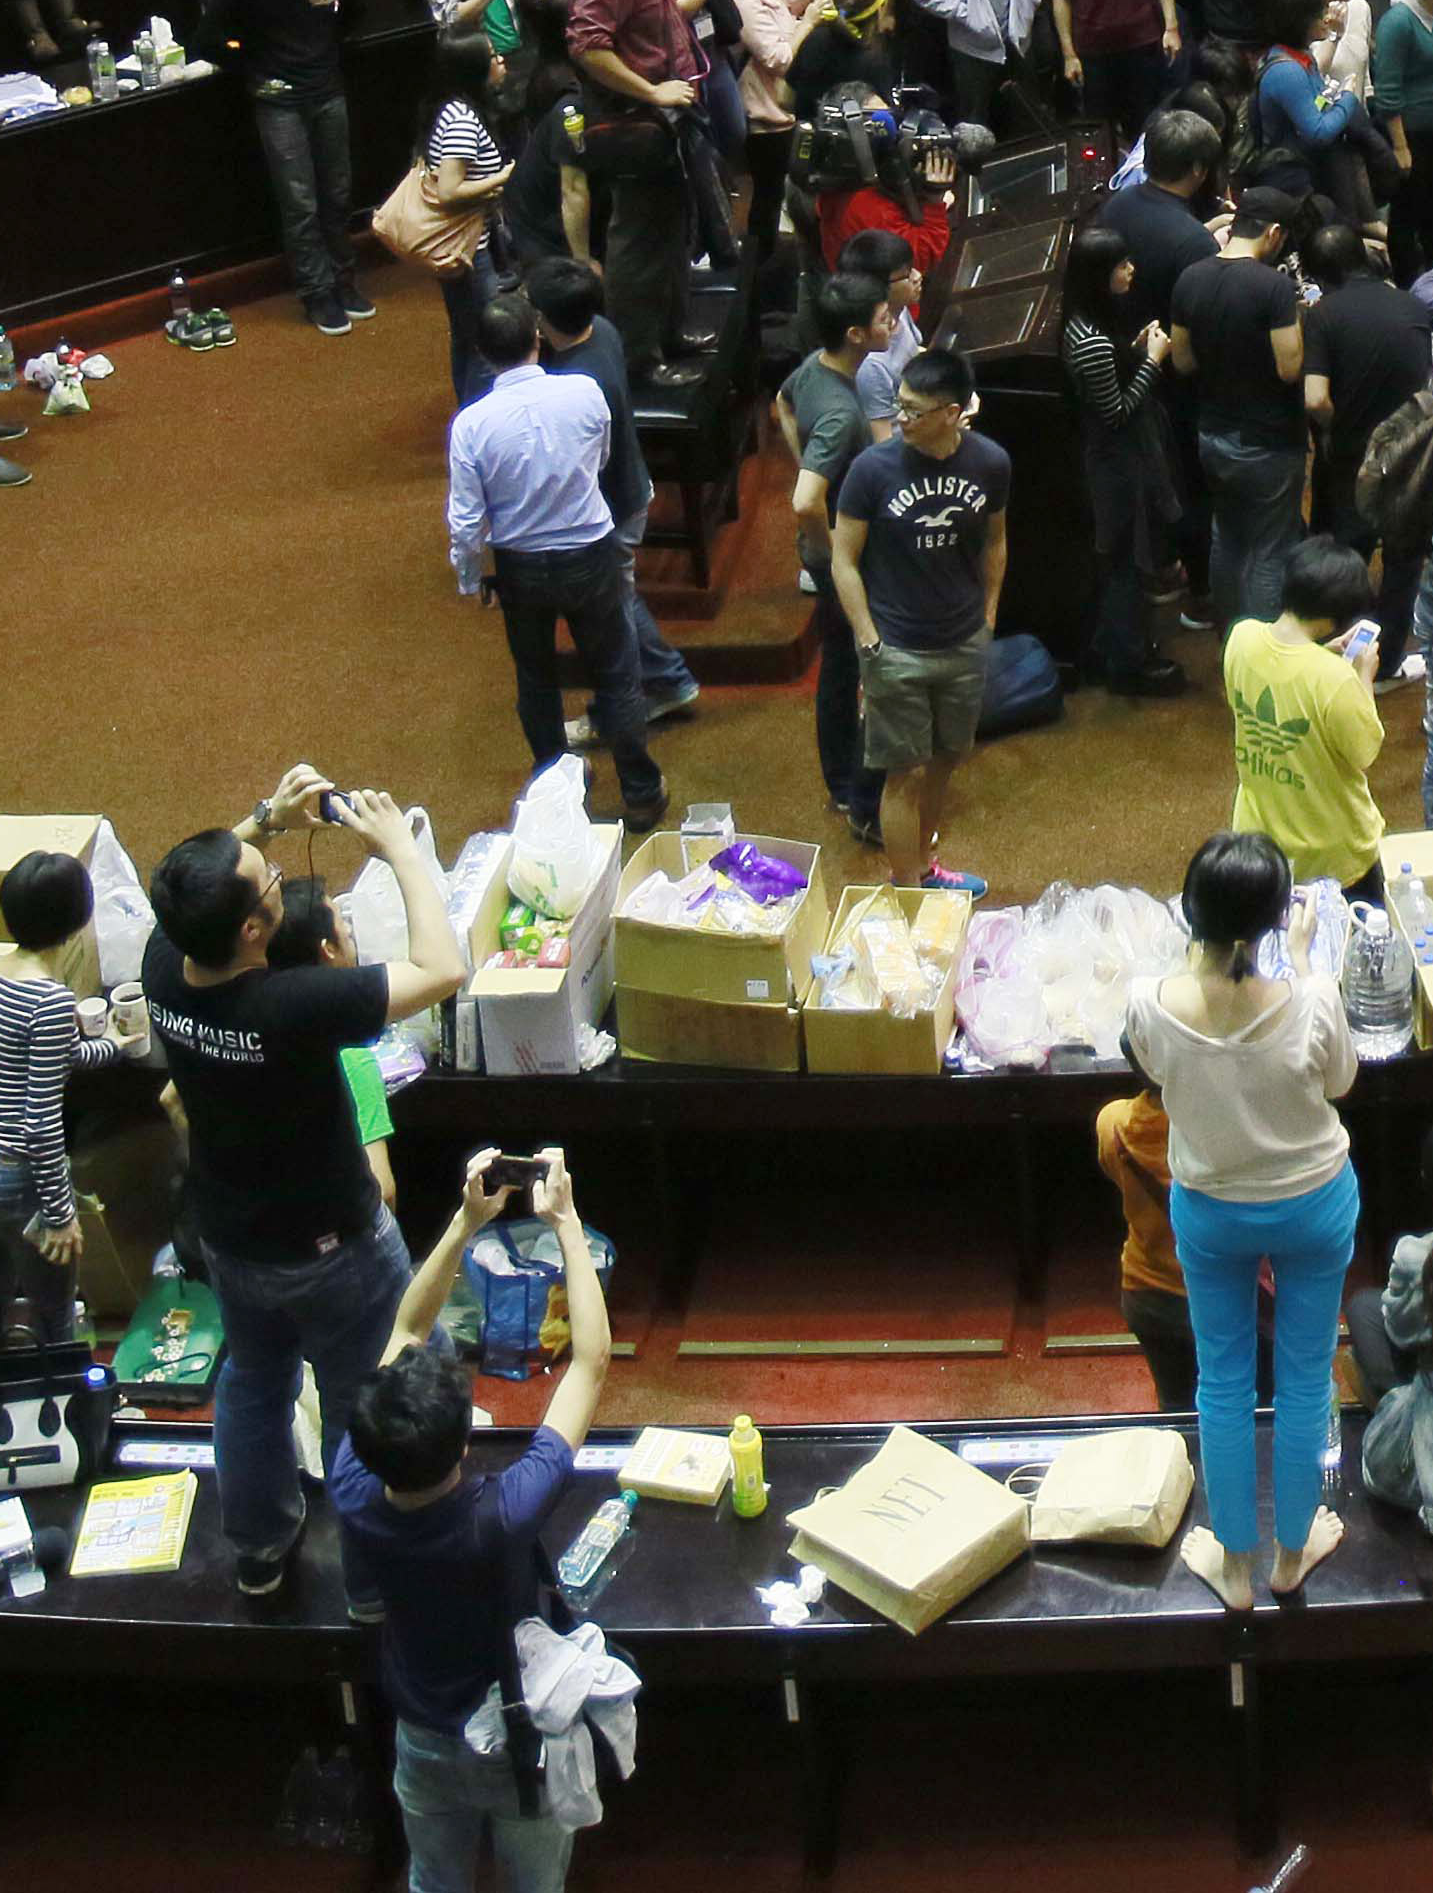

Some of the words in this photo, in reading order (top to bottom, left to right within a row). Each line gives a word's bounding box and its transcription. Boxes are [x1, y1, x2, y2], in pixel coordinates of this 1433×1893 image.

[887, 476, 987, 517] HOLLISTER
[148, 999, 193, 1037] SING
[861, 1472, 949, 1533] NET
